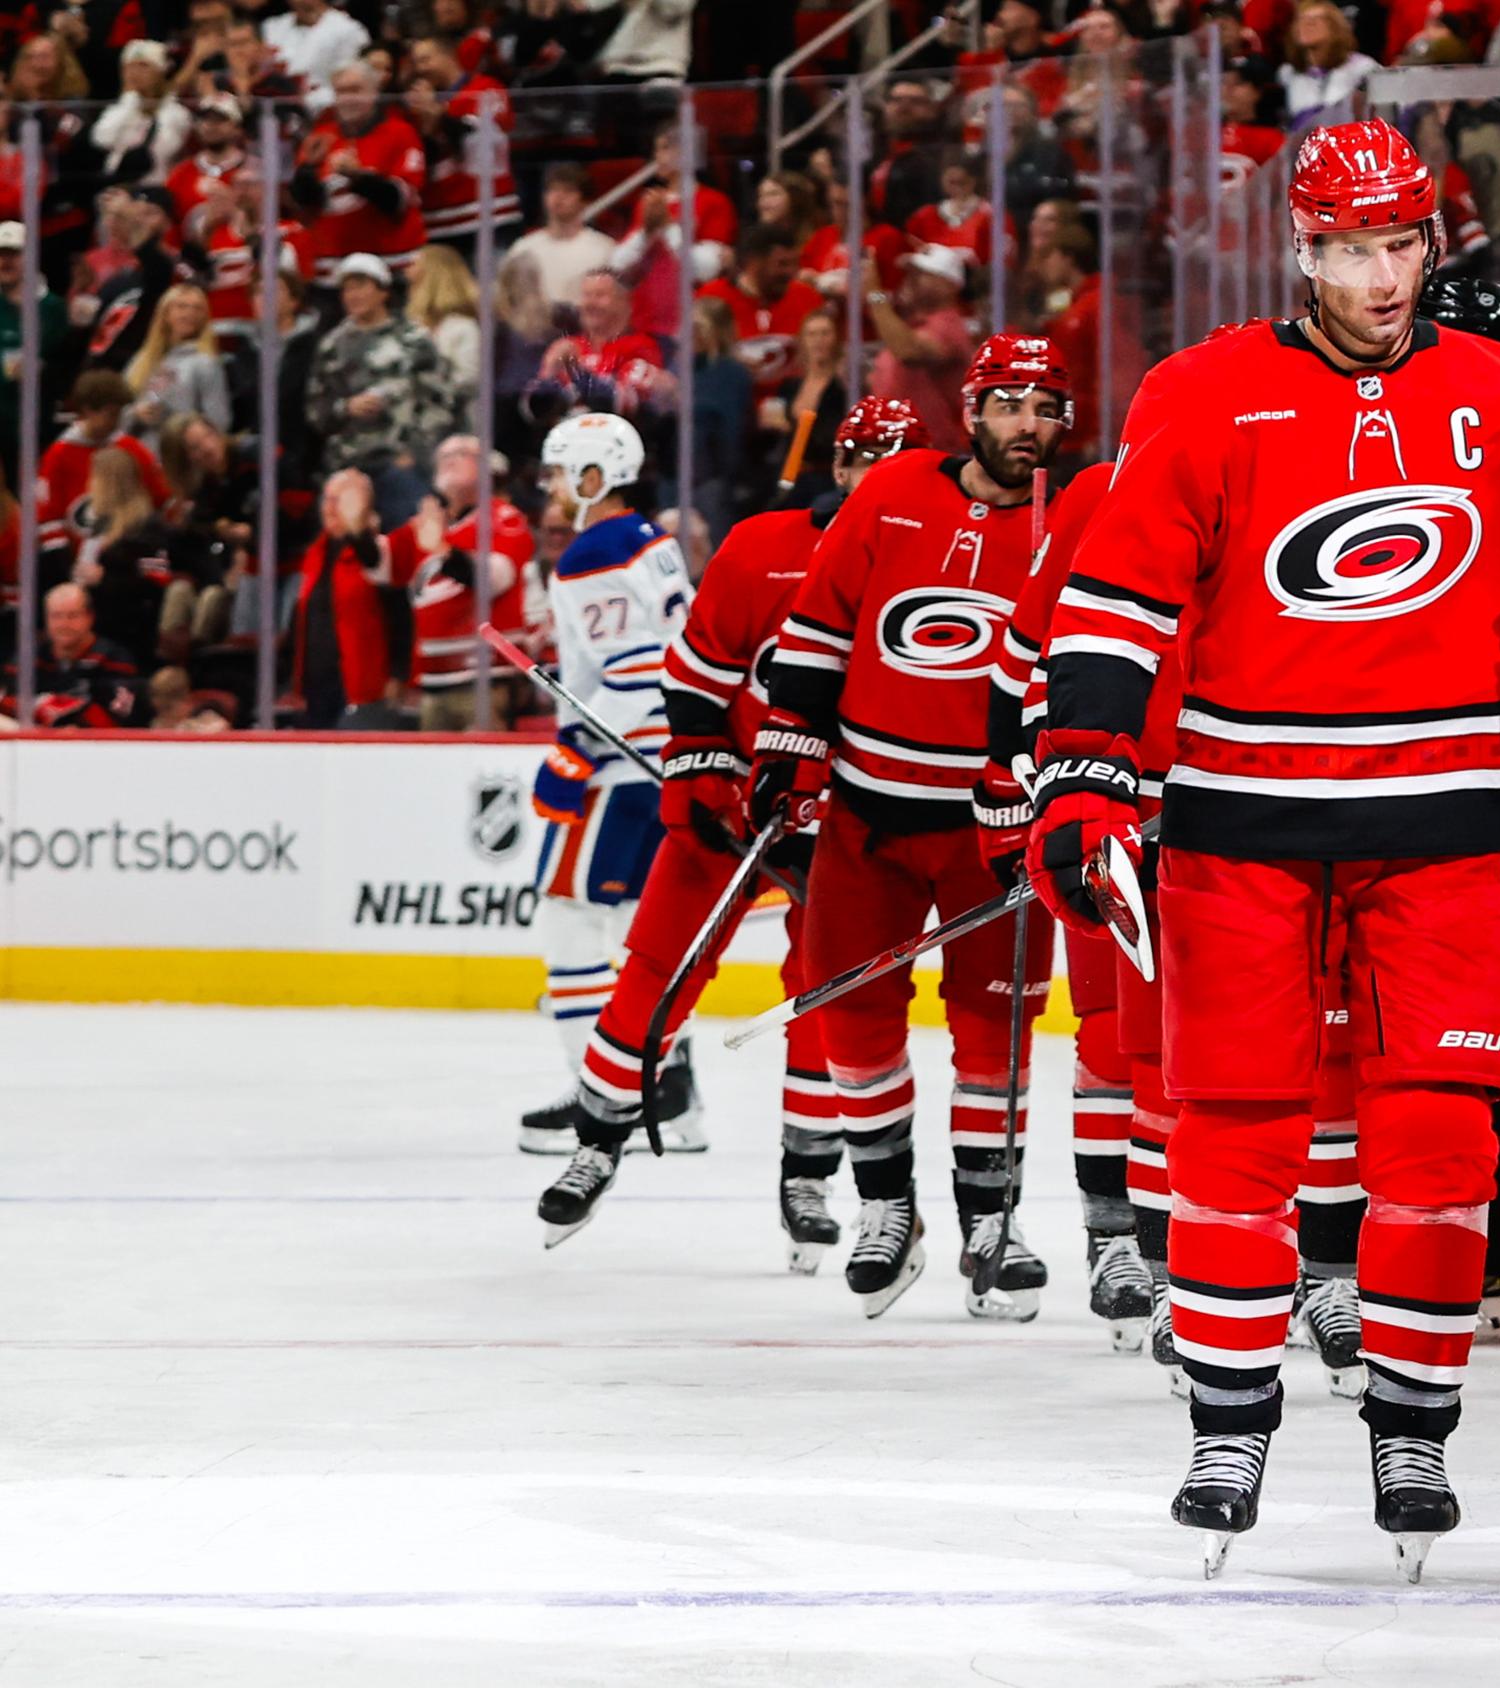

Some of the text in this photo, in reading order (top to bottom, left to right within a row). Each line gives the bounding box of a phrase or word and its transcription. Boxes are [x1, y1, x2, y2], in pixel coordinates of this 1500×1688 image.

[1353, 149, 1378, 174] 11
[1233, 409, 1297, 426] NUCOR
[1450, 406, 1484, 471] C
[582, 596, 629, 641] 27
[0, 818, 299, 883] portsbook
[354, 882, 536, 927] NHLSHO
